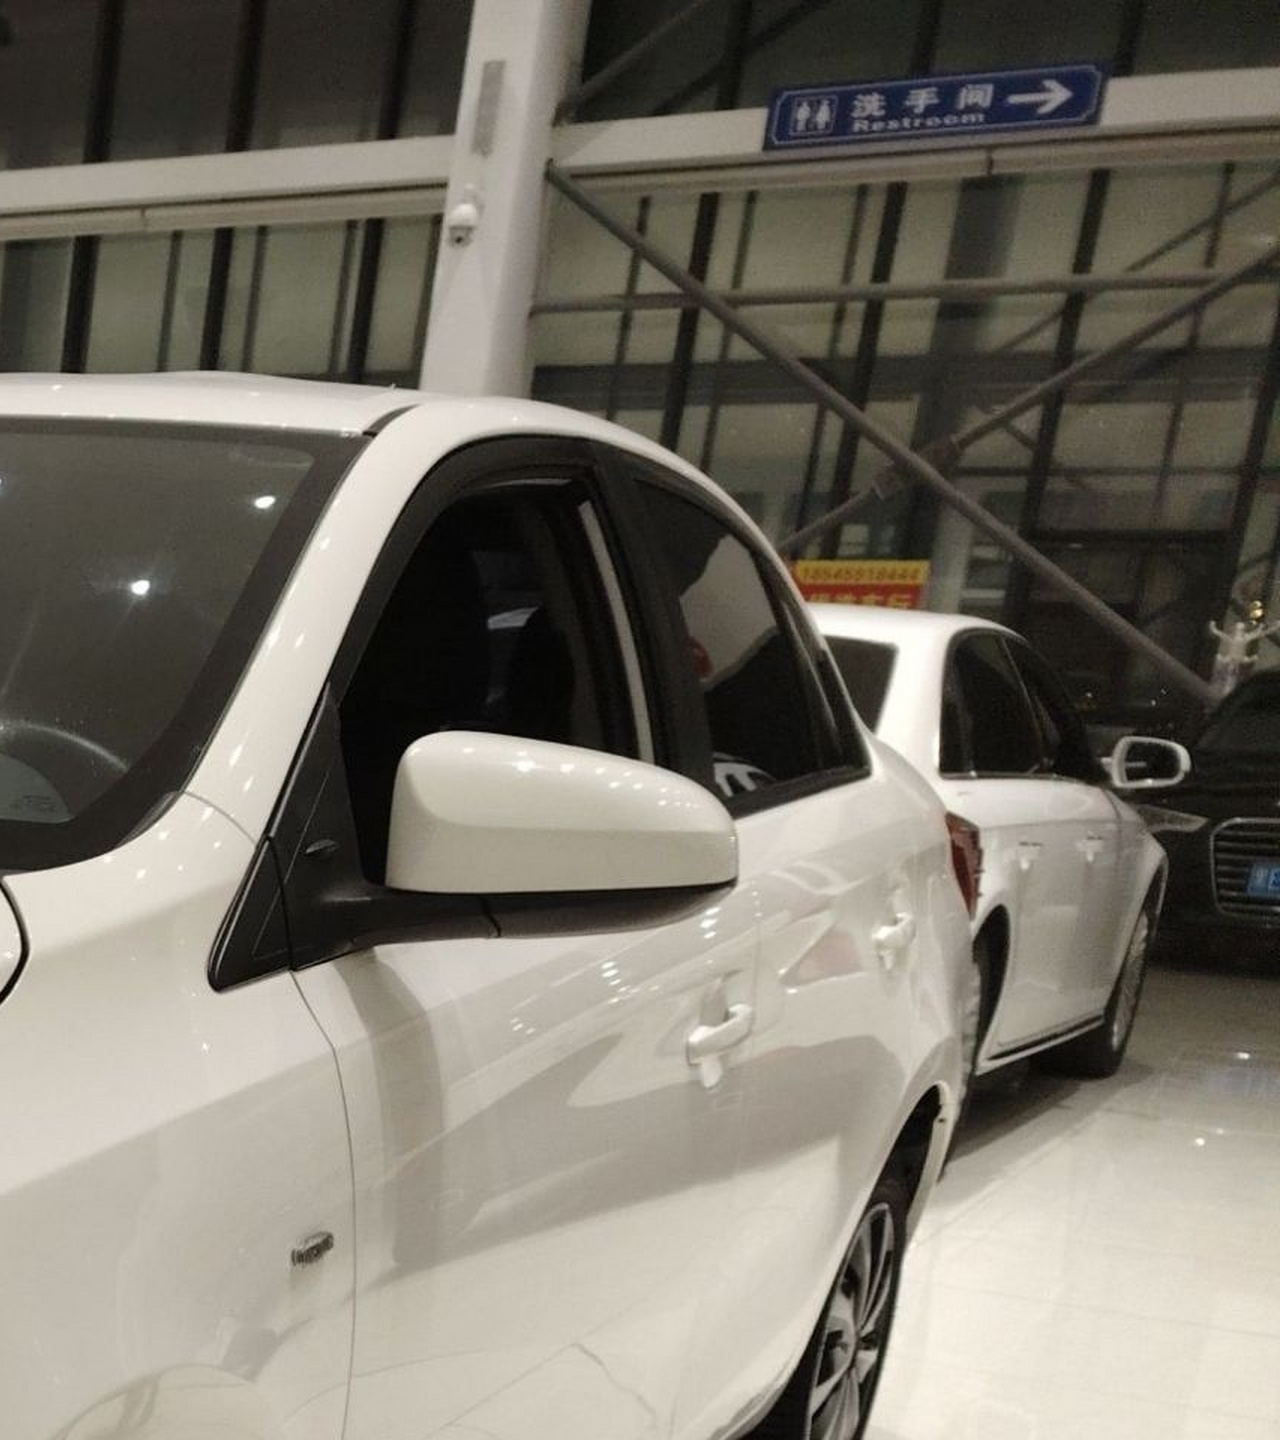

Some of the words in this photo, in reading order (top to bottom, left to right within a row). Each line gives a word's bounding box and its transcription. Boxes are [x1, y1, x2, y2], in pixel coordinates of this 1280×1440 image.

[851, 83, 995, 118] 洗手间
[852, 112, 986, 134] Restroom
